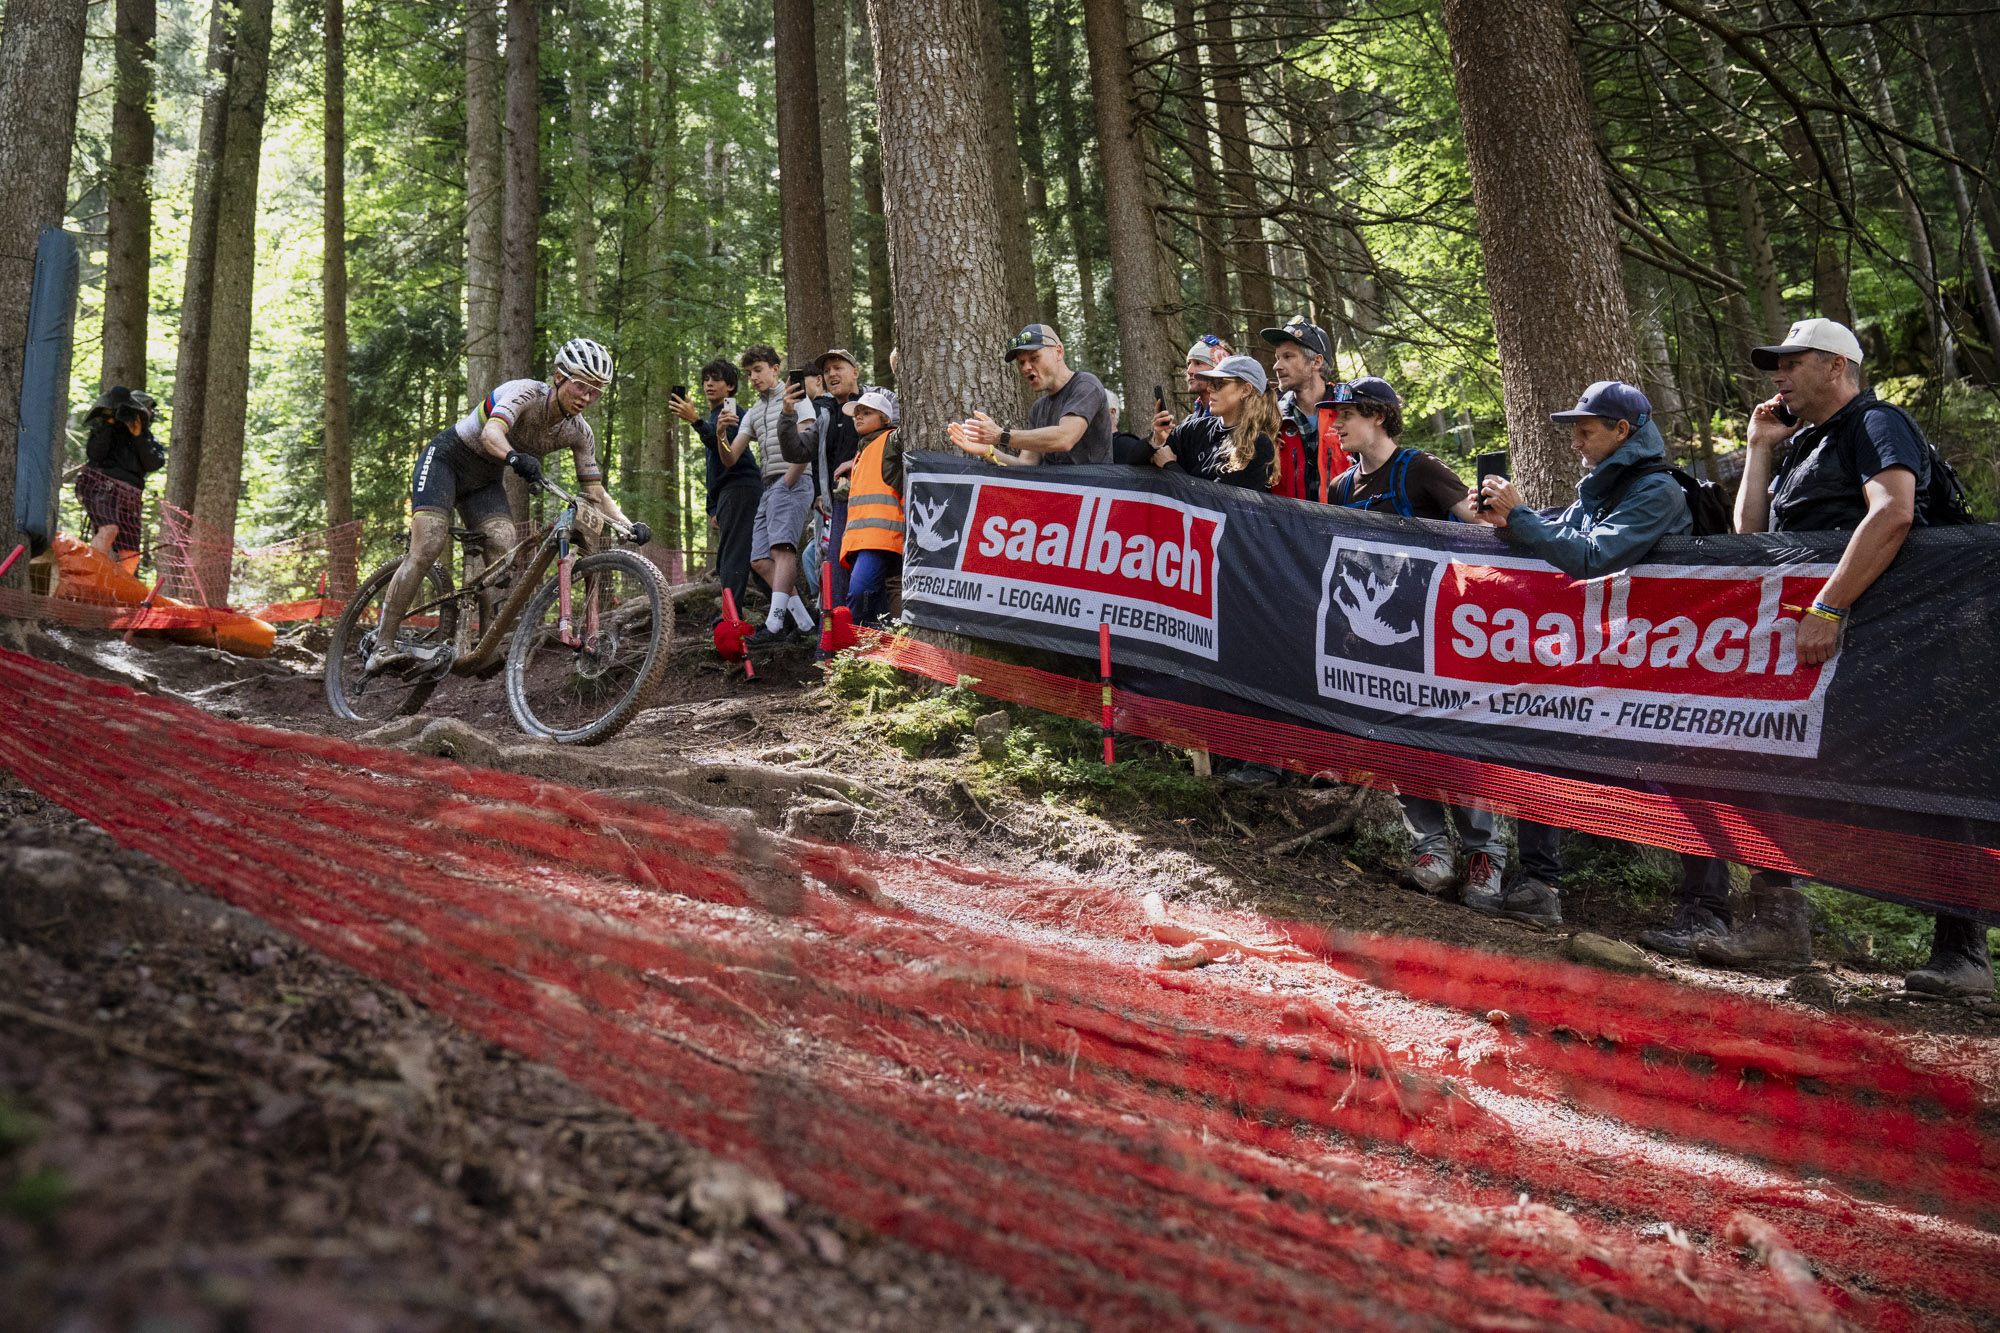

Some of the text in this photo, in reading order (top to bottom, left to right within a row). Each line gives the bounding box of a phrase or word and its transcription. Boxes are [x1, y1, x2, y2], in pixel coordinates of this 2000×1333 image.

[417, 446, 436, 492] SRAM
[582, 510, 599, 529] 69
[978, 494, 1203, 596] saalbach
[998, 586, 1081, 618] LEOGANG
[1100, 603, 1213, 649] FIEBERBRUNN
[1451, 575, 1798, 676] saalbach
[1324, 666, 1471, 710] HINTERGLEMM
[1489, 692, 1594, 722] LEOGANG
[1615, 701, 1808, 743] FIEBERBRUNN
